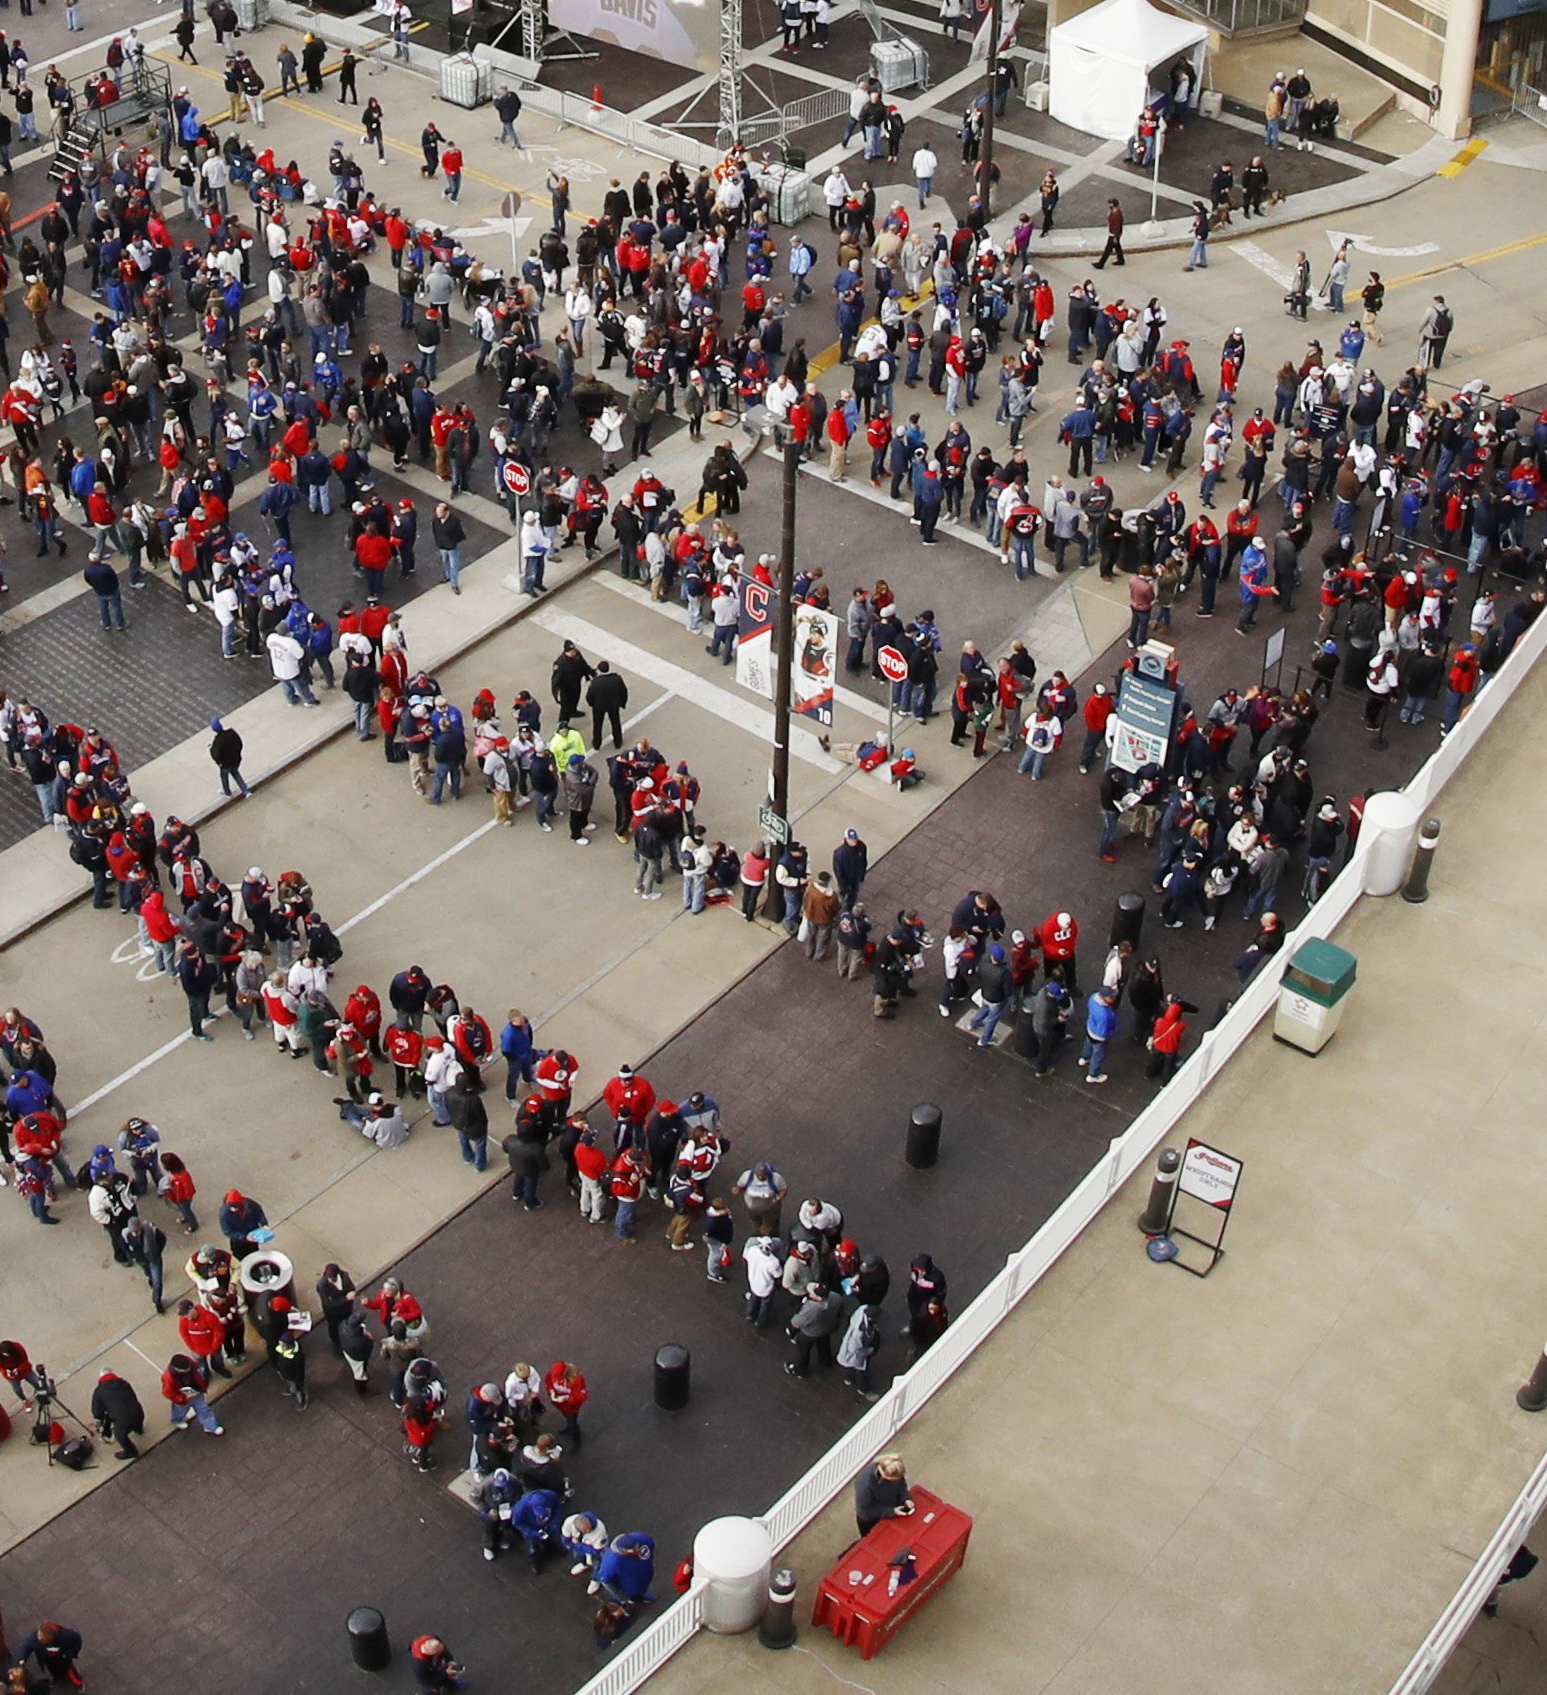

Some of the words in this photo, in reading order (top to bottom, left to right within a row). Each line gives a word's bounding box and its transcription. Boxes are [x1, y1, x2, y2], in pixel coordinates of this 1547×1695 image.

[505, 468, 527, 487] STOP
[745, 584, 769, 623] C
[273, 649, 285, 662] 12
[880, 651, 907, 675] STOP
[817, 707, 832, 724] 10
[1054, 929, 1072, 942] CLE
